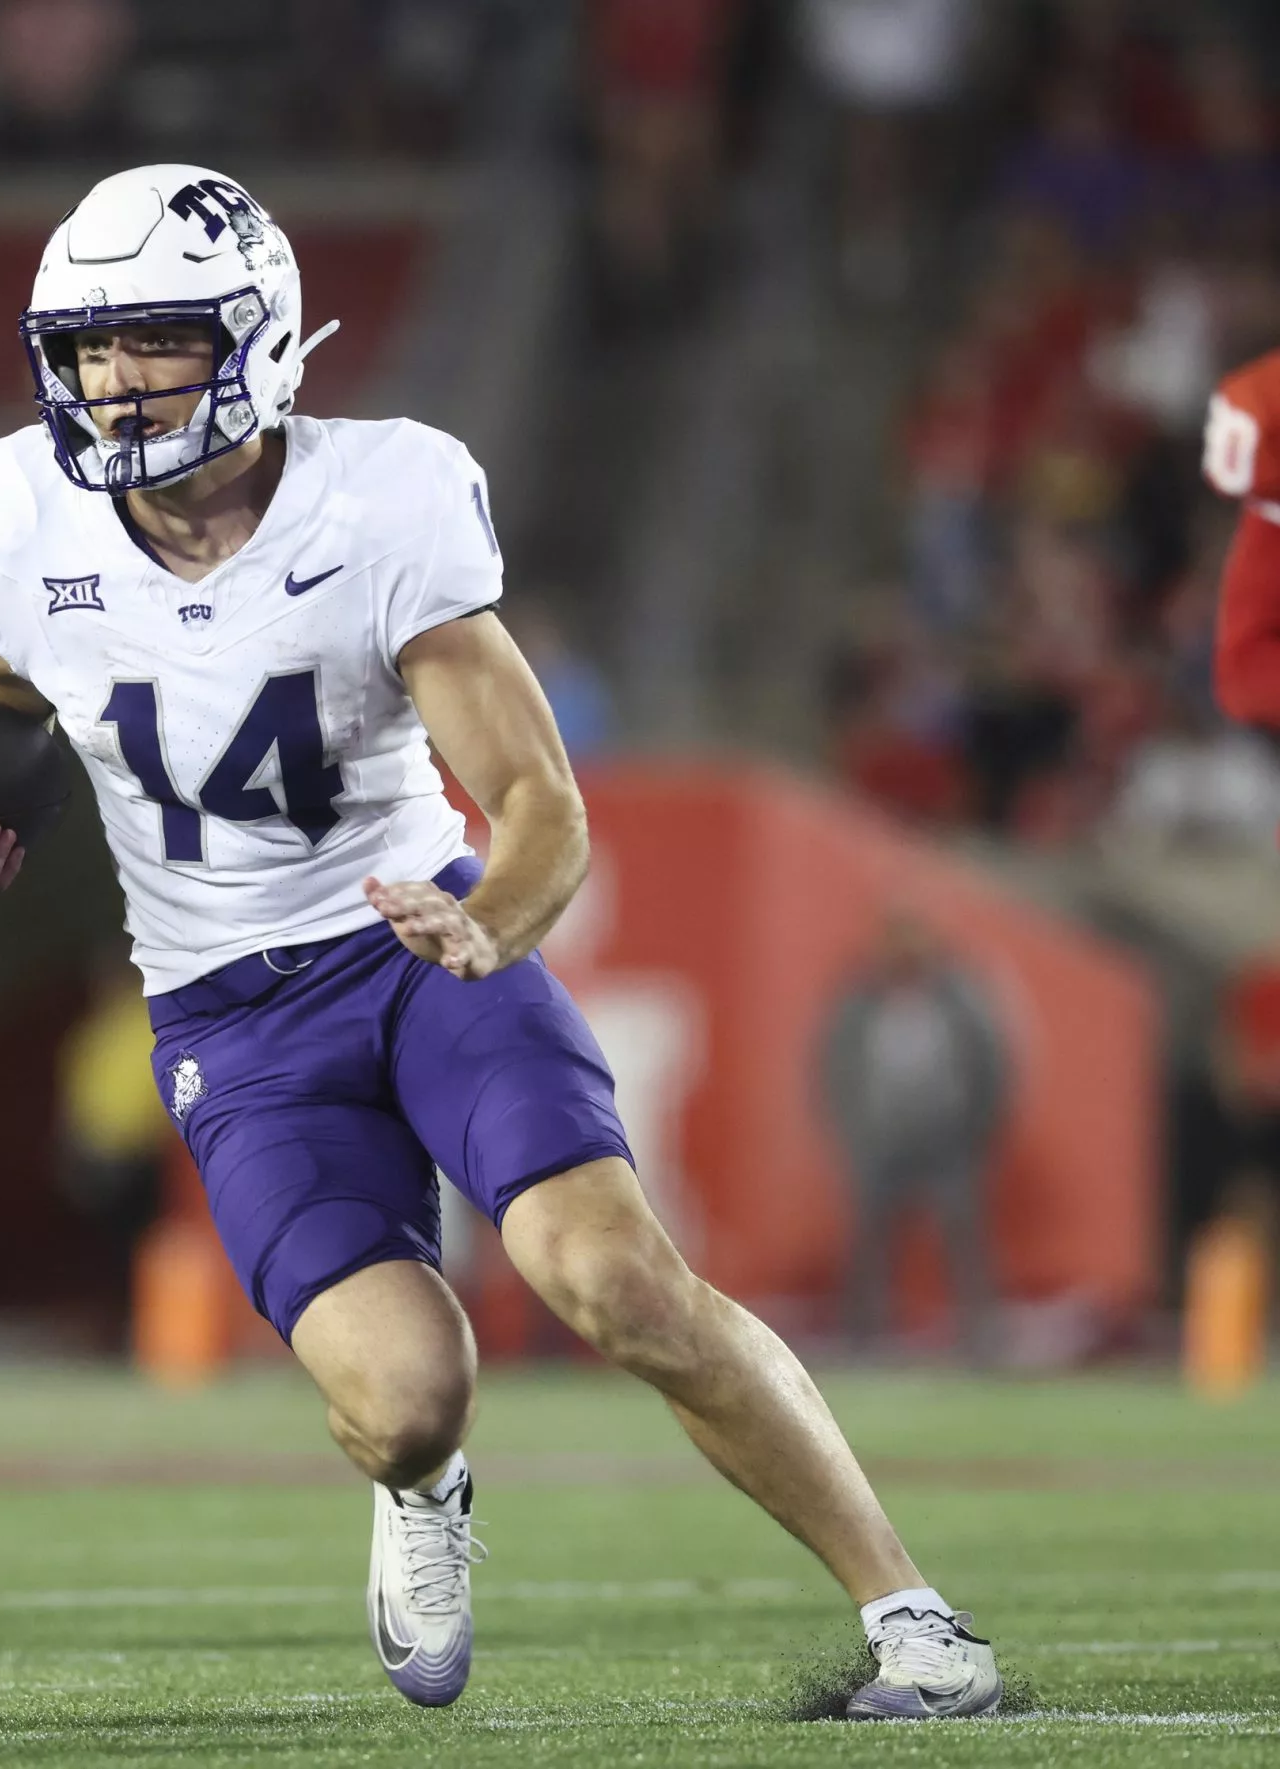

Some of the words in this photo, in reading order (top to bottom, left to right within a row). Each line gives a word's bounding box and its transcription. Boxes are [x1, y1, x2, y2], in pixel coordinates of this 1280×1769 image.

[49, 381, 82, 418] FROS
[178, 603, 212, 622] TCU
[95, 664, 352, 871] 14
